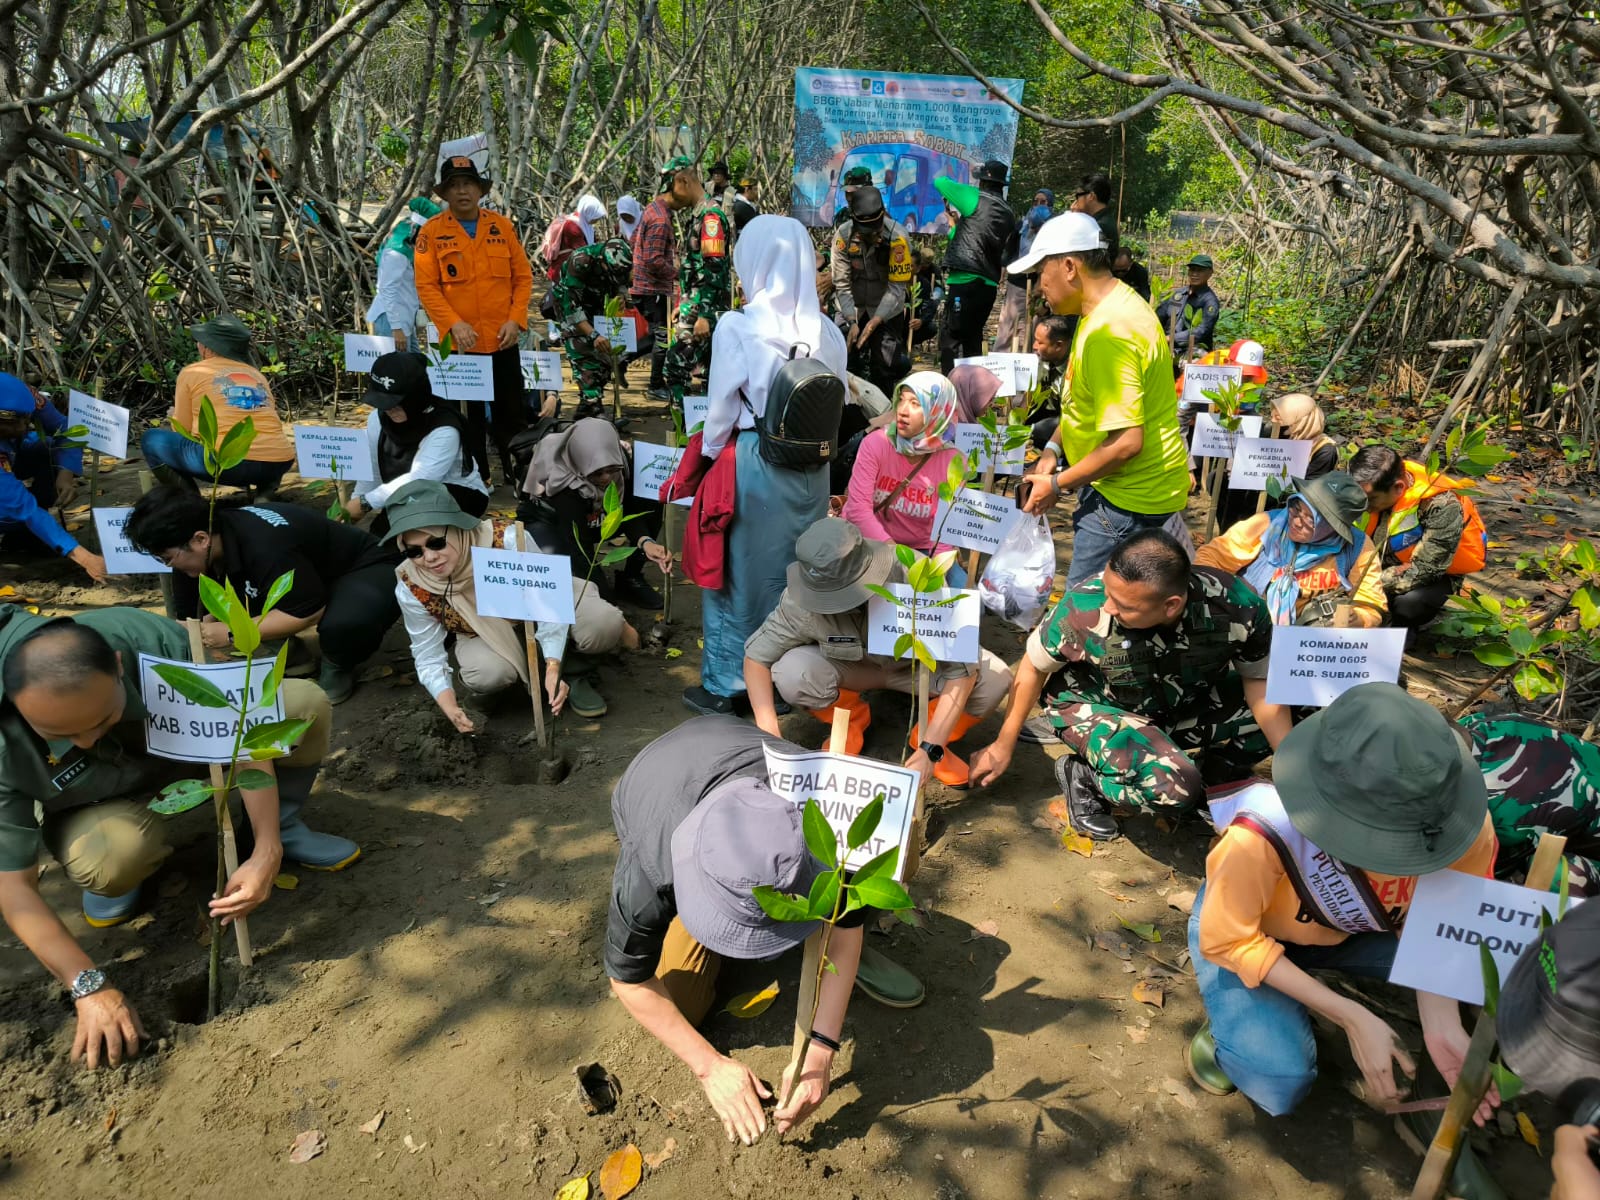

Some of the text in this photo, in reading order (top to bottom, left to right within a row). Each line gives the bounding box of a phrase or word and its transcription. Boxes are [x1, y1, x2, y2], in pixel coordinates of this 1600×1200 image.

[813, 95, 842, 106] BBGP
[844, 97, 872, 108] Jabar
[874, 98, 921, 111] Menanam
[952, 104, 1001, 117] Mangrove
[886, 110, 904, 120] Hari
[907, 111, 950, 123] Mangrove
[952, 114, 987, 125] Sedunia
[1188, 372, 1219, 382] KADIS
[984, 503, 1009, 514] DINAS
[967, 521, 984, 531] DAN
[946, 527, 999, 545] KEBUDAYAAN
[487, 560, 550, 574] KETUA DWP
[483, 575, 557, 590] KAB. SUBANG
[897, 611, 942, 623] DAERAH
[882, 624, 908, 635] KAB.
[1299, 640, 1369, 650] KOMANDAN
[1296, 654, 1368, 664] KODIM 0605
[1289, 668, 1371, 679] KAB. SUBANG
[157, 684, 180, 703] PJ.
[149, 713, 185, 736] KAB.
[768, 767, 902, 804] KEPALA BBGP
[1312, 850, 1354, 907] PUTERI
[1435, 922, 1523, 956] INDON
